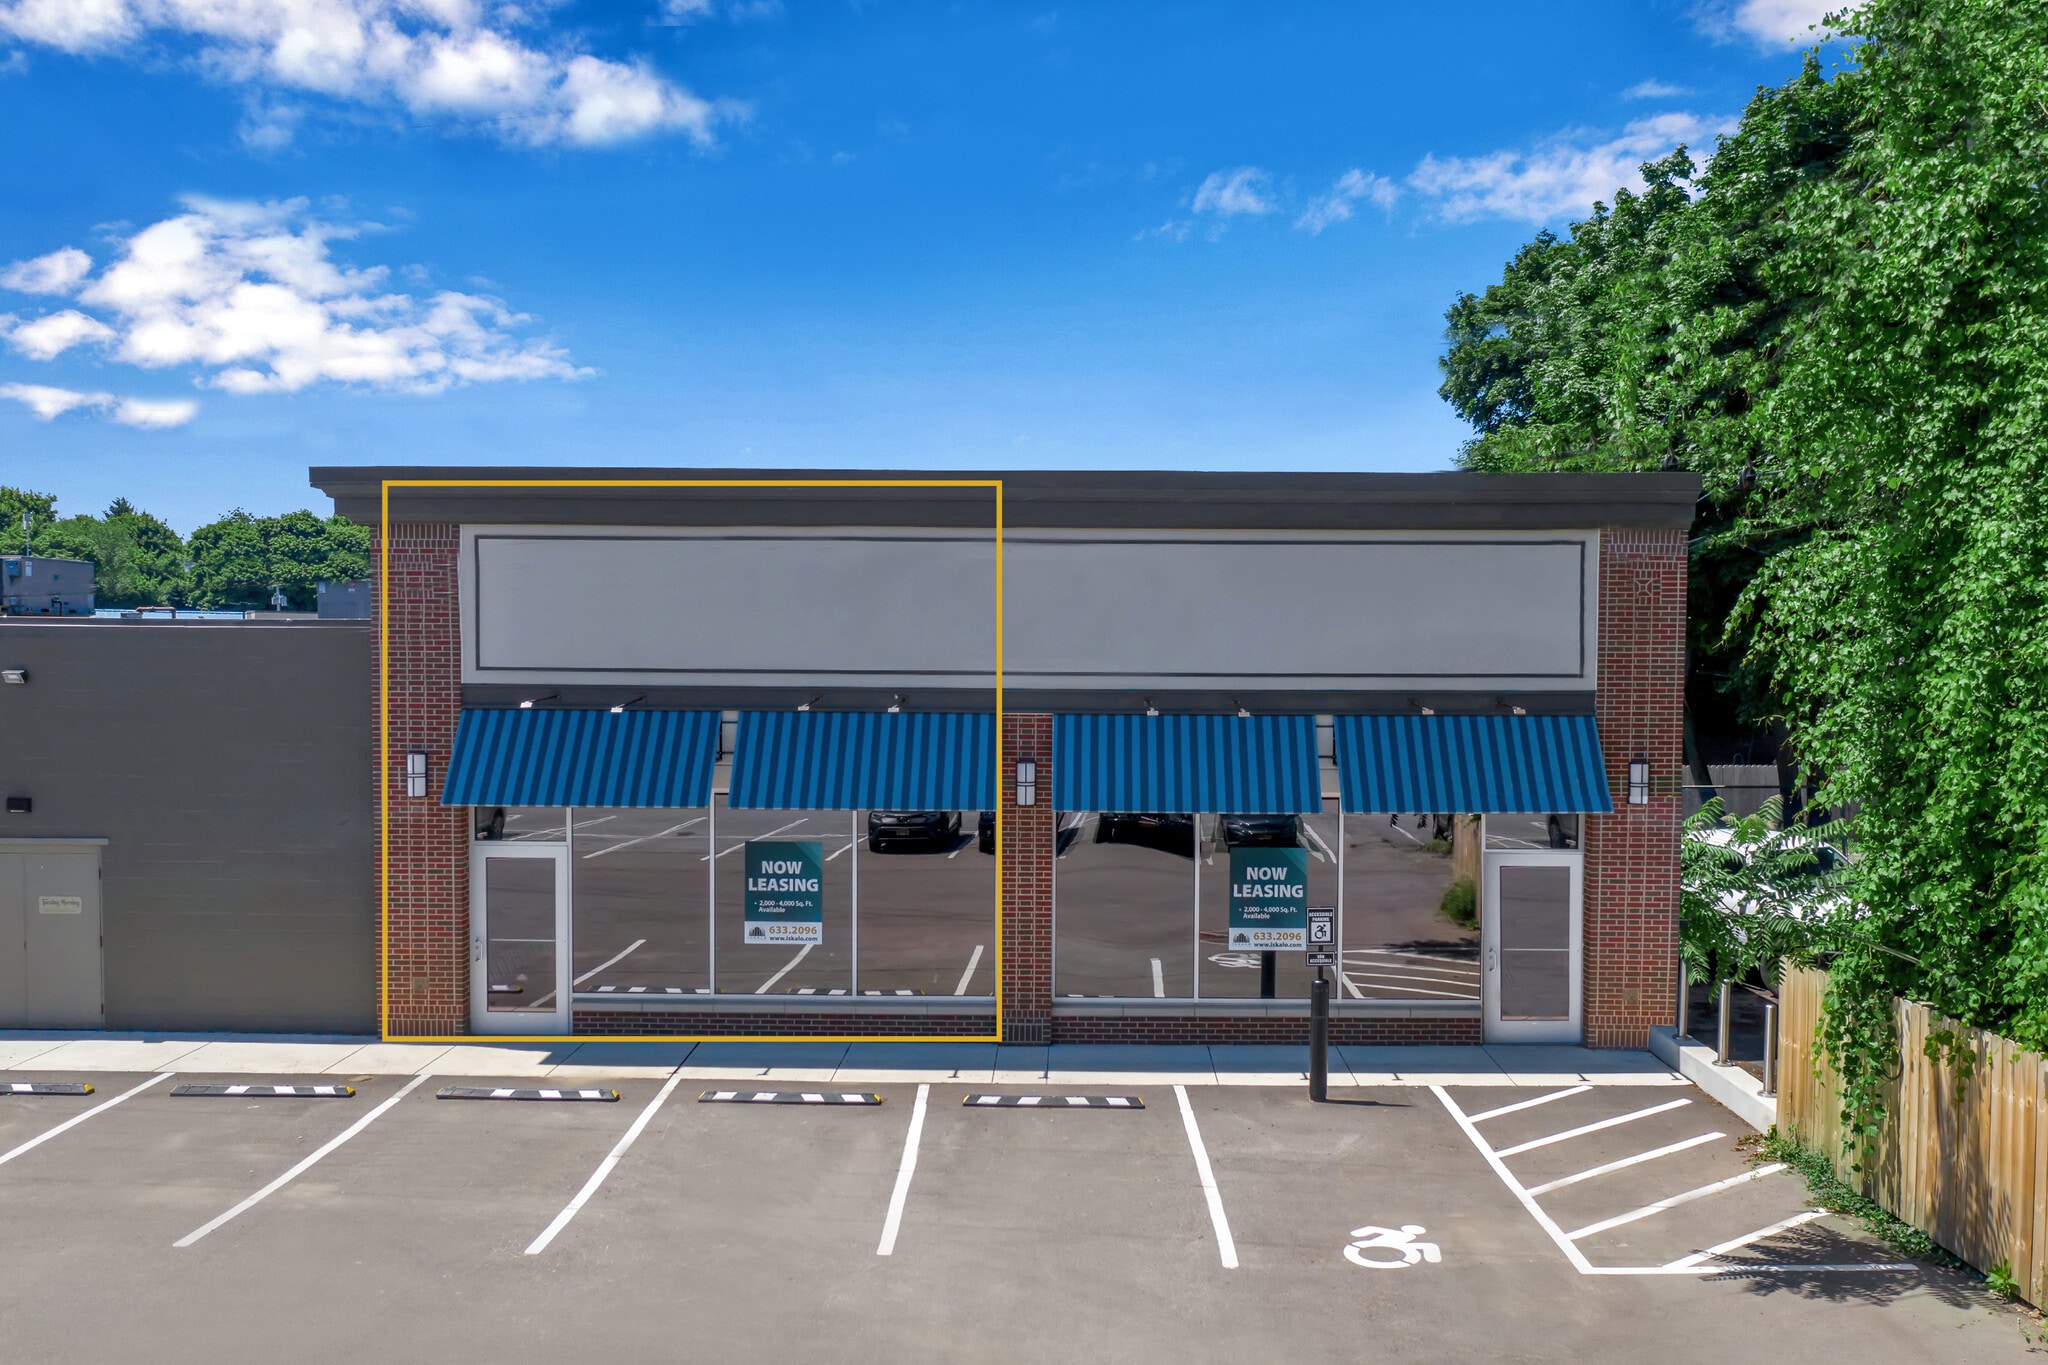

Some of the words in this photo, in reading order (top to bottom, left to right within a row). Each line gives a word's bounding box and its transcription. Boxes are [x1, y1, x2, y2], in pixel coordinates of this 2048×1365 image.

[762, 861, 802, 874] NOW
[1246, 867, 1288, 880] NOW
[748, 878, 818, 892] LEASING
[1233, 884, 1304, 898] LEASING
[769, 926, 817, 934] 633.2096
[1253, 932, 1302, 940] 633.2096
